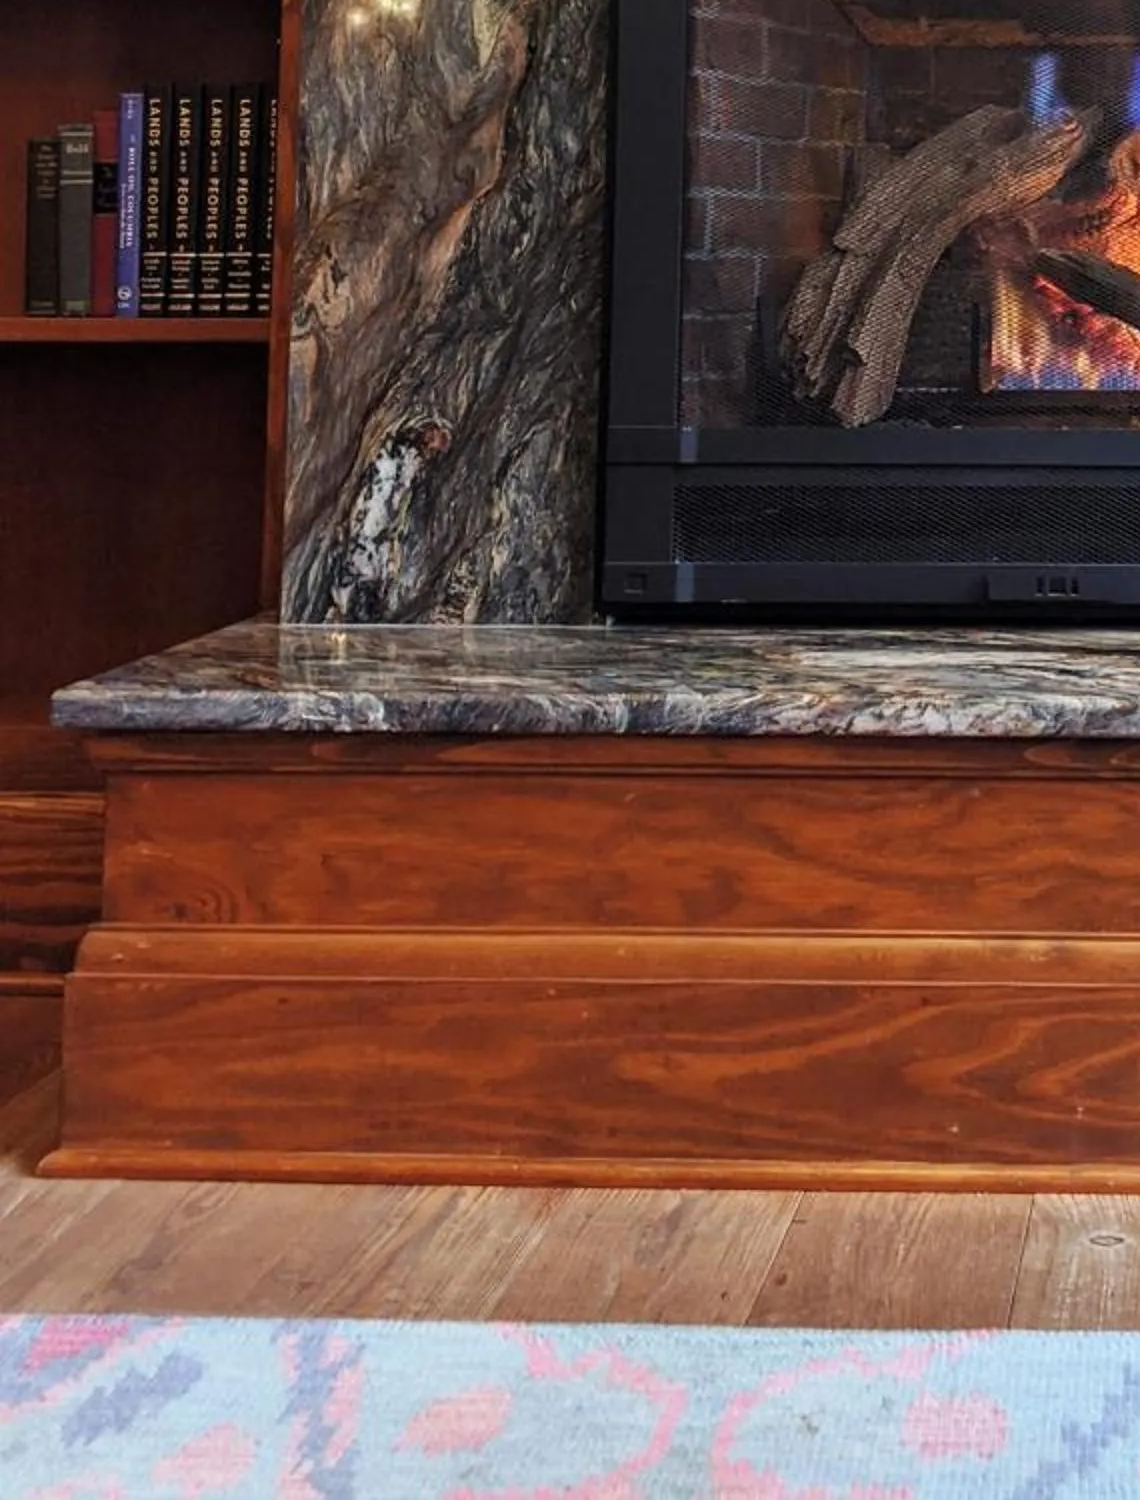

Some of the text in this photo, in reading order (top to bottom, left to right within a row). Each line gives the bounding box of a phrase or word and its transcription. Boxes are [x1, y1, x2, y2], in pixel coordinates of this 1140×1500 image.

[148, 98, 161, 147] LANDS
[179, 98, 192, 147] LANDS
[209, 98, 223, 147] LANDS
[239, 98, 252, 147] LANDS
[146, 177, 159, 239] PEOPLES
[175, 177, 189, 239] PEOPLES
[206, 177, 220, 239] PEOPLES
[235, 177, 249, 239] PEOPLES
